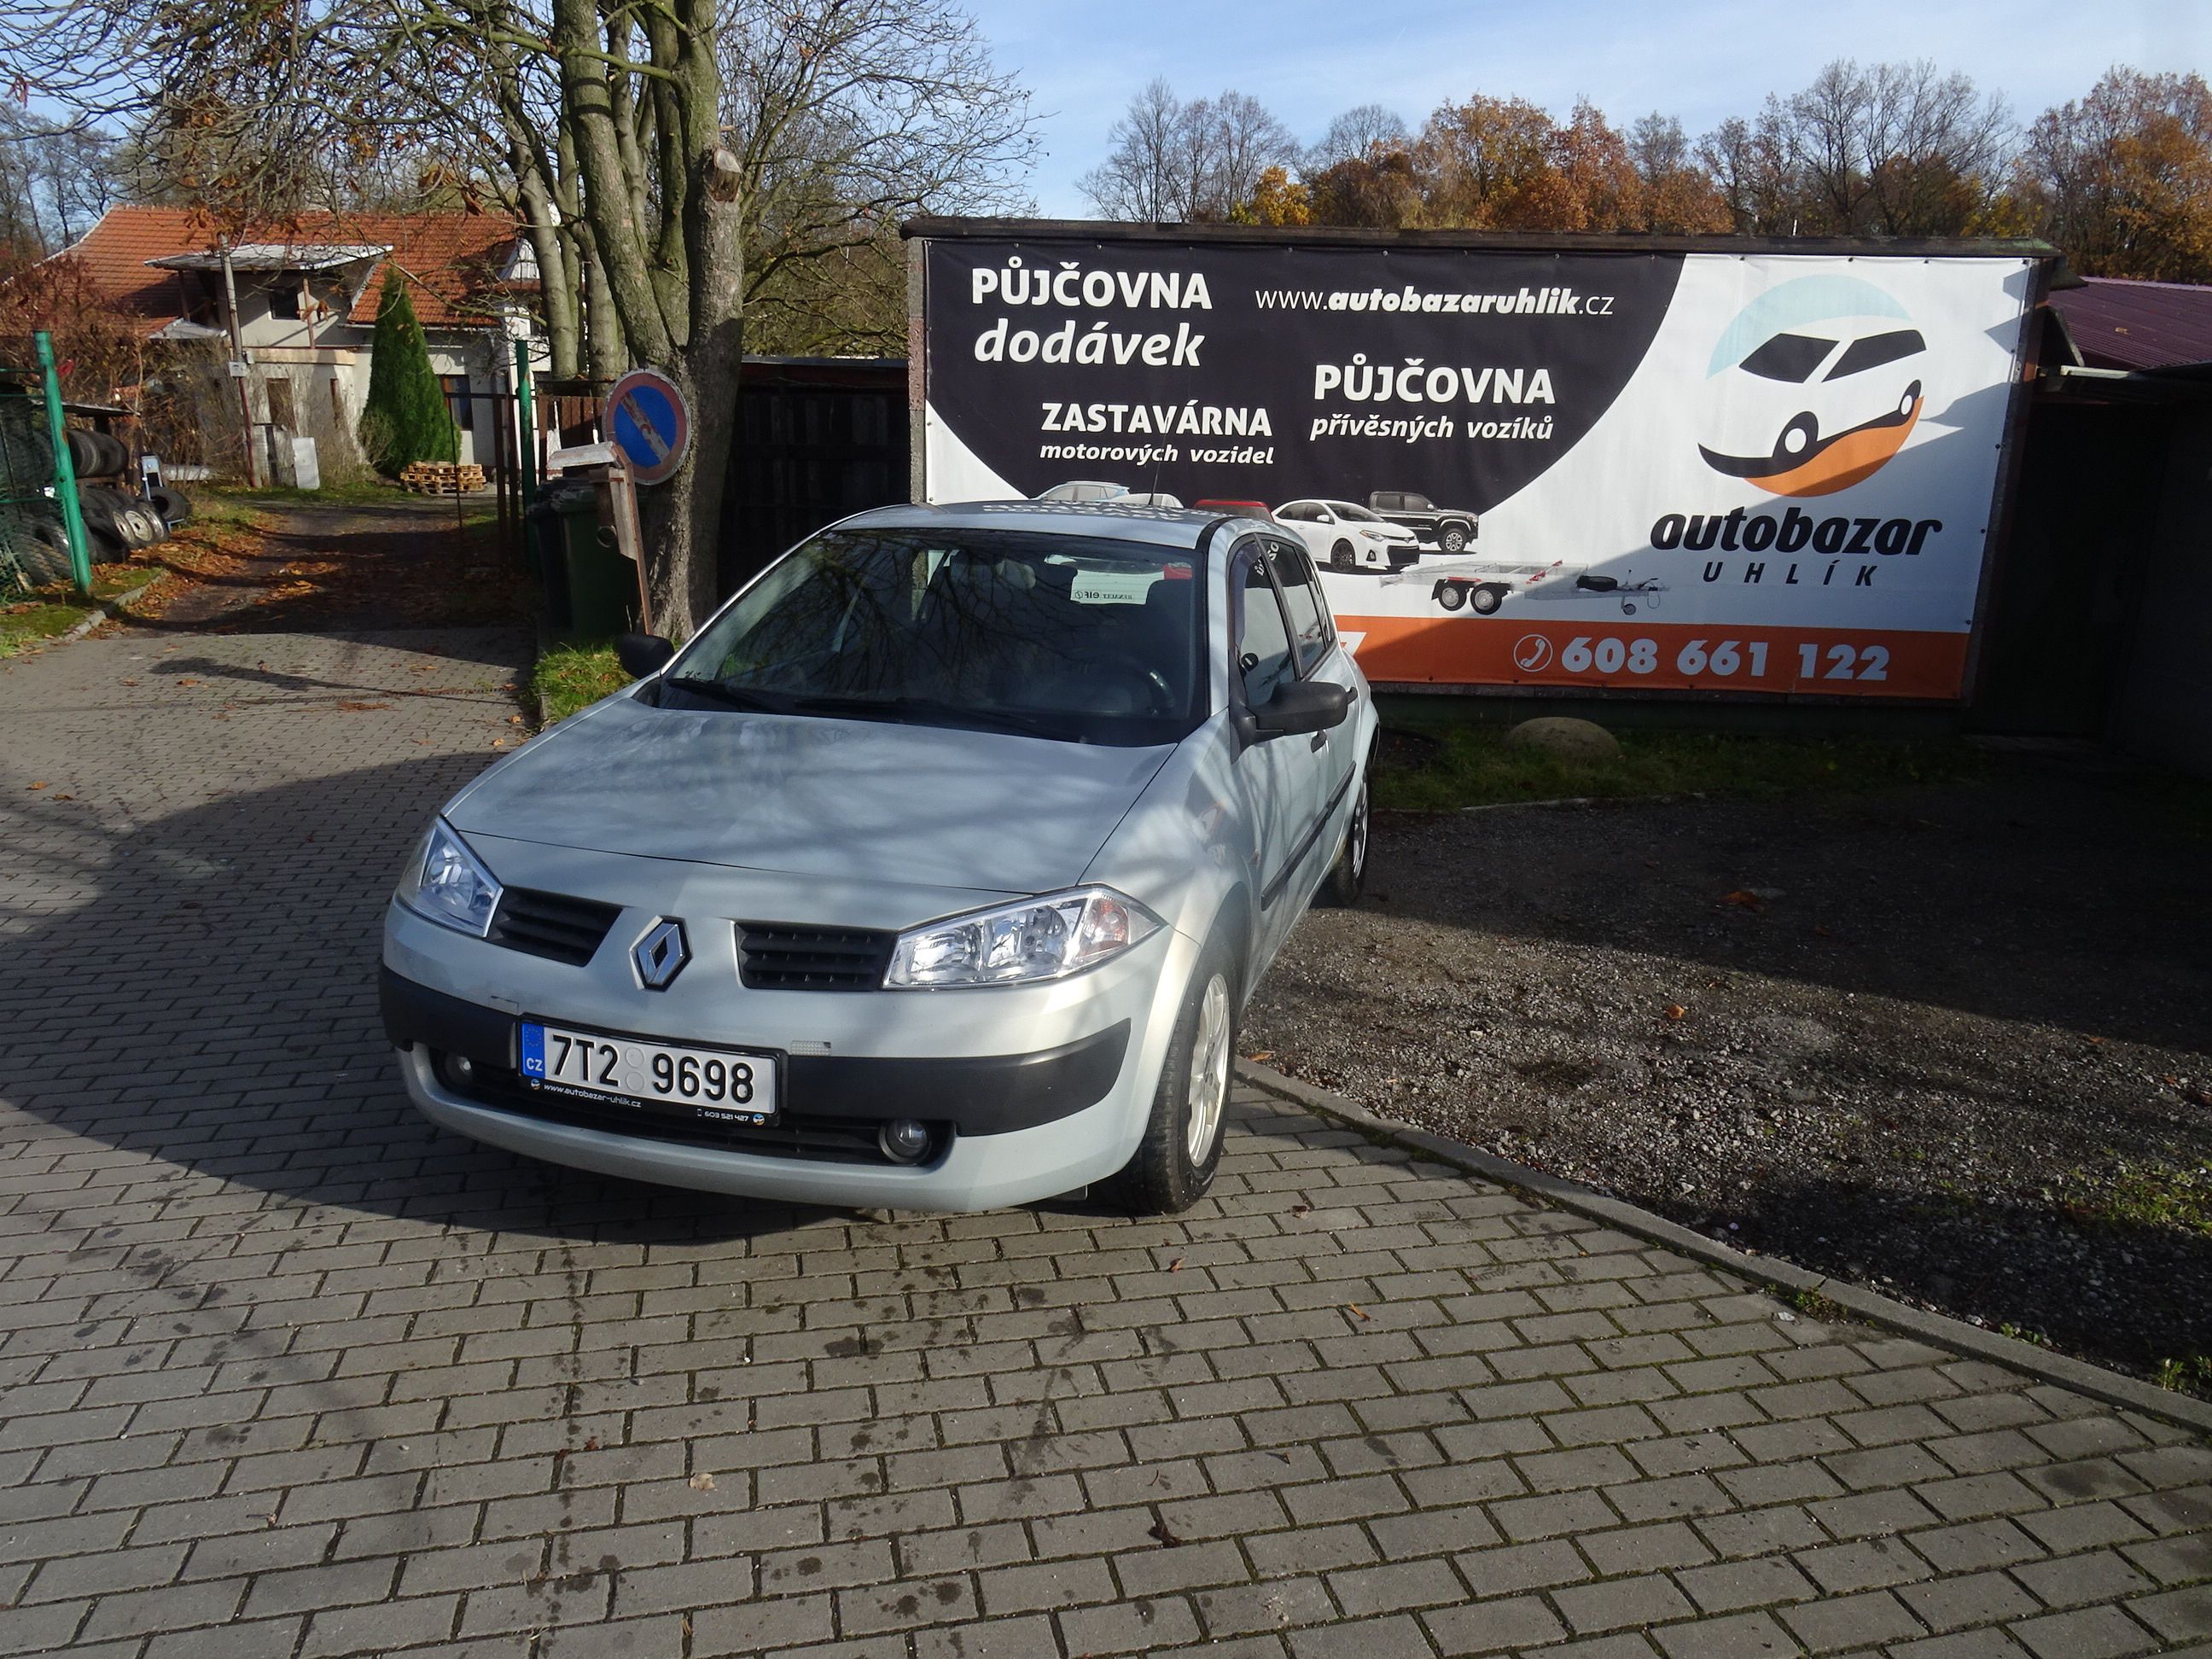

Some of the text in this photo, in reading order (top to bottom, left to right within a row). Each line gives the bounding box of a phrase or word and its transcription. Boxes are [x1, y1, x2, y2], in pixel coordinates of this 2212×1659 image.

[972, 255, 1213, 310] PŮJČOVNA
[1254, 285, 1615, 315] www.autobazaruhlik.cz
[974, 317, 1206, 367] dodávek
[1314, 352, 1556, 405] PŮJČOVNA
[1041, 399, 1272, 437] ZASTAVÁRNA
[1309, 413, 1554, 444] přívěsných vozíků
[1039, 443, 1274, 466] motorových vozidel
[1650, 506, 1943, 556] autobazar
[1703, 559, 1878, 587] UHLÍK
[1562, 637, 1891, 681] 608 661 122
[526, 1057, 544, 1072] CZ
[552, 1033, 755, 1104] 7T2 9698
